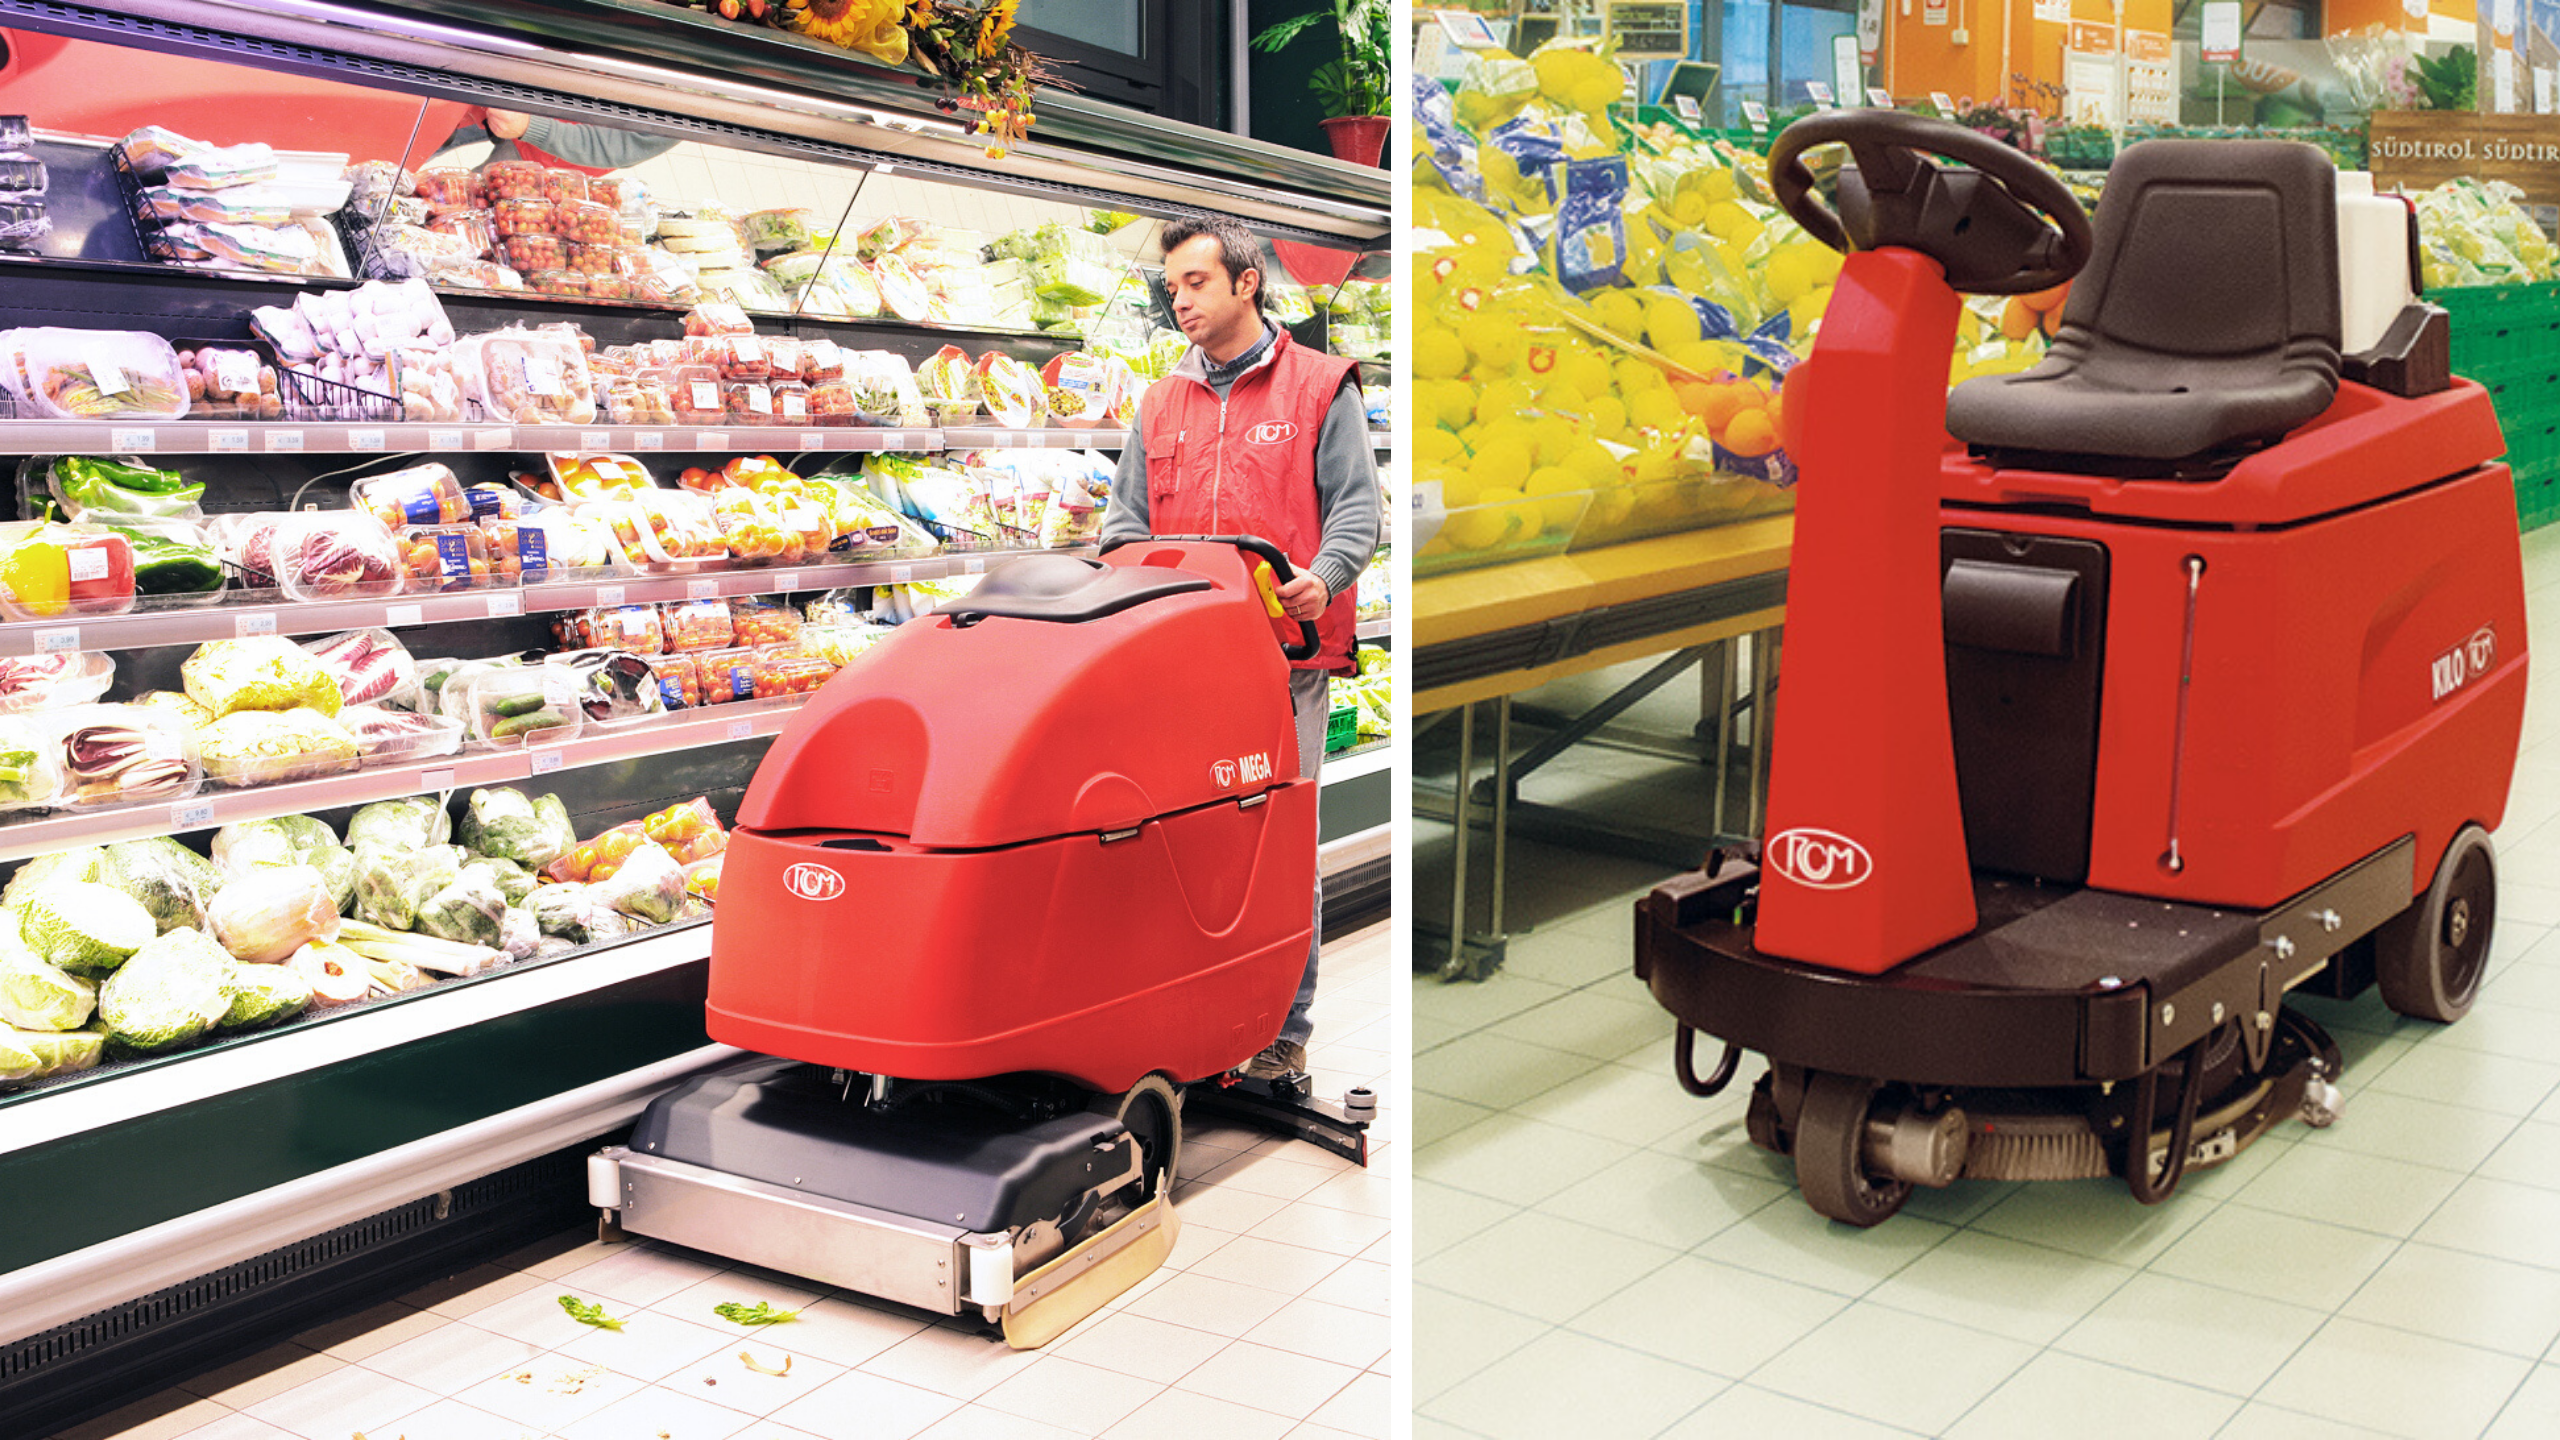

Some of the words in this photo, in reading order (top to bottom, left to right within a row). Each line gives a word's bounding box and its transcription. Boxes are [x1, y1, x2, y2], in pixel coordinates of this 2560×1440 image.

[2432, 647, 2466, 700] KILO
[1238, 751, 1273, 784] MEGA
[1786, 835, 1855, 881] RCM
[793, 866, 835, 896] RCM
